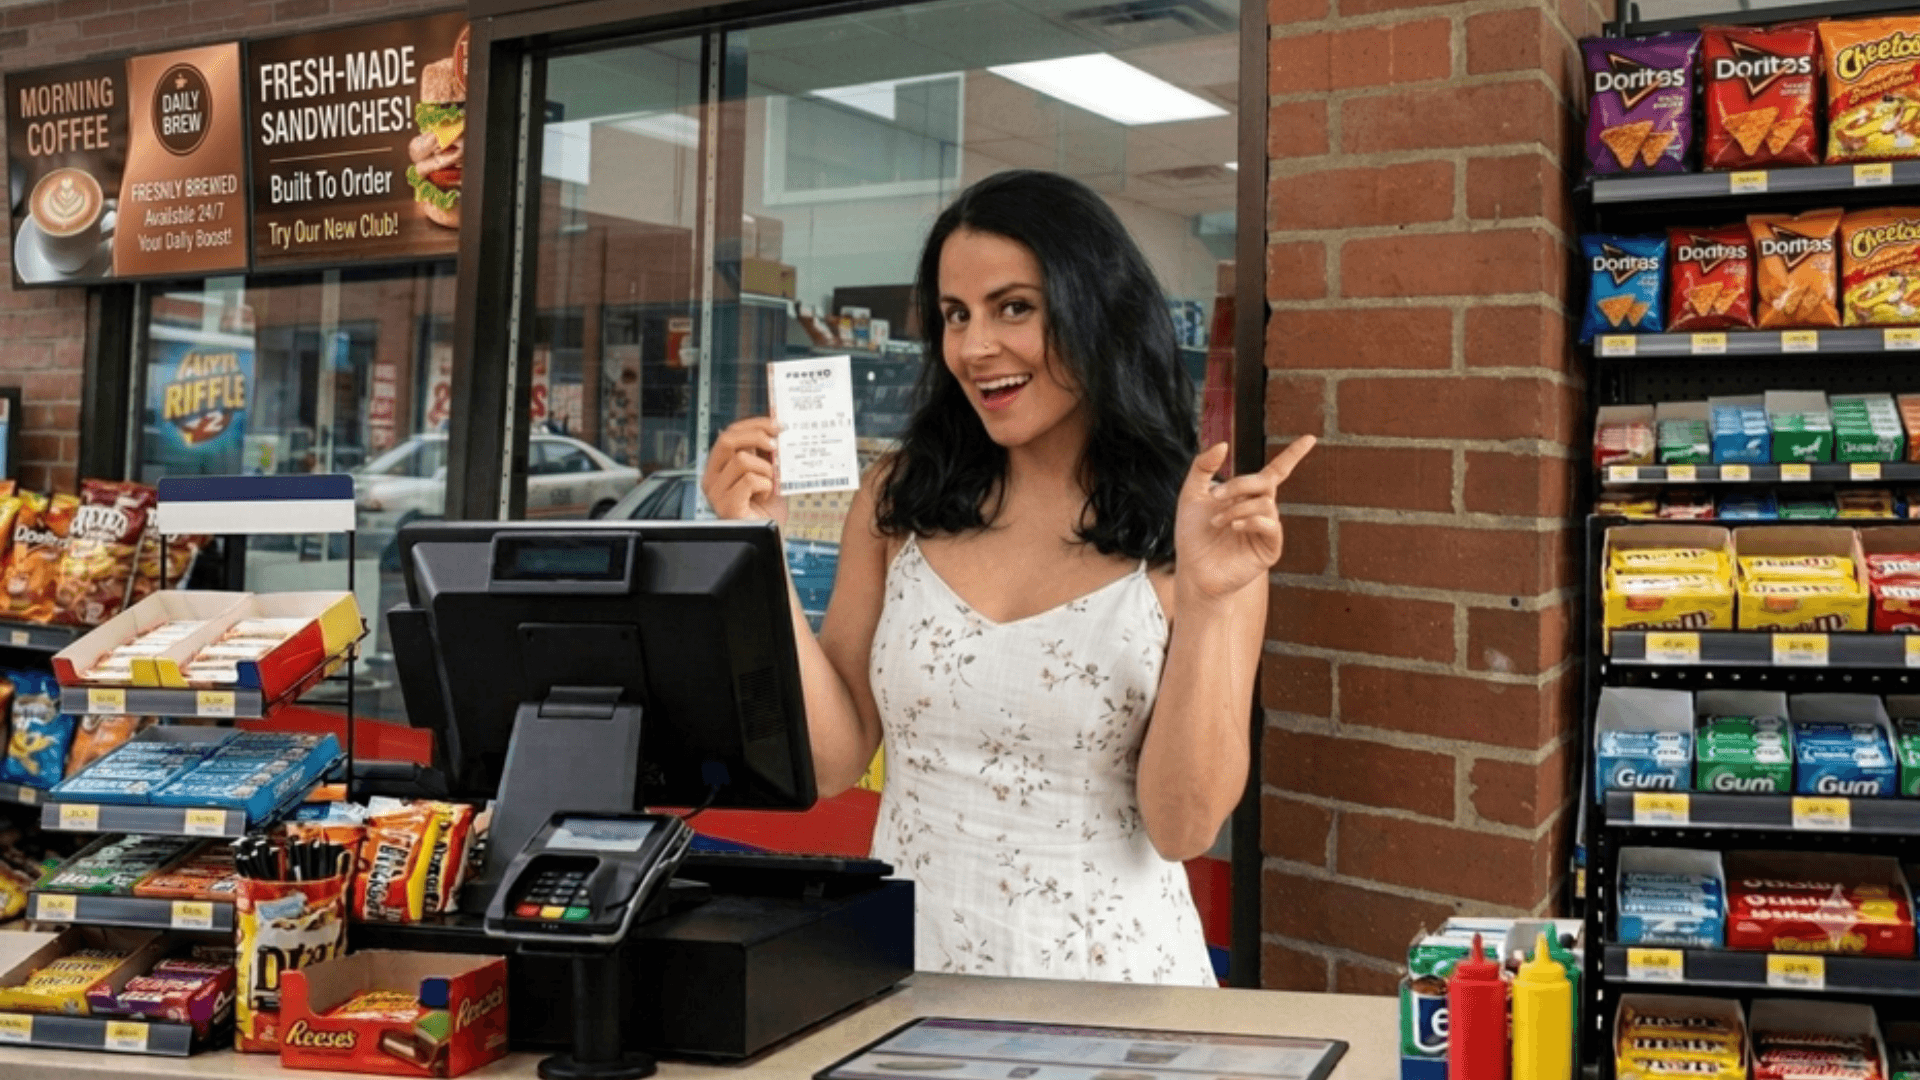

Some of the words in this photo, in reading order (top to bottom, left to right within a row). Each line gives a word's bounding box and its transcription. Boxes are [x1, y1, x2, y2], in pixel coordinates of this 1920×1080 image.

[260, 45, 416, 102] FRESH-MADE
[1716, 56, 1811, 79] Doritos
[1595, 68, 1686, 92] Doritos
[20, 76, 114, 118] MORNING
[162, 90, 200, 113] DAILY
[163, 112, 202, 135] BREW
[261, 95, 412, 145] SANDWICHES!
[27, 114, 109, 156] COFFEE
[271, 171, 312, 203] Built
[316, 169, 337, 199] To
[341, 165, 393, 197] Order
[269, 222, 291, 250] Try
[294, 220, 321, 243] Our
[324, 217, 357, 240] New
[360, 212, 399, 238] Club!
[1678, 244, 1747, 262] Doritos
[1762, 237, 1832, 255] Doritos
[1593, 256, 1659, 272] Doritos
[1617, 768, 1677, 789] Gum
[1715, 773, 1775, 792] Gum
[1818, 775, 1879, 795] Gum
